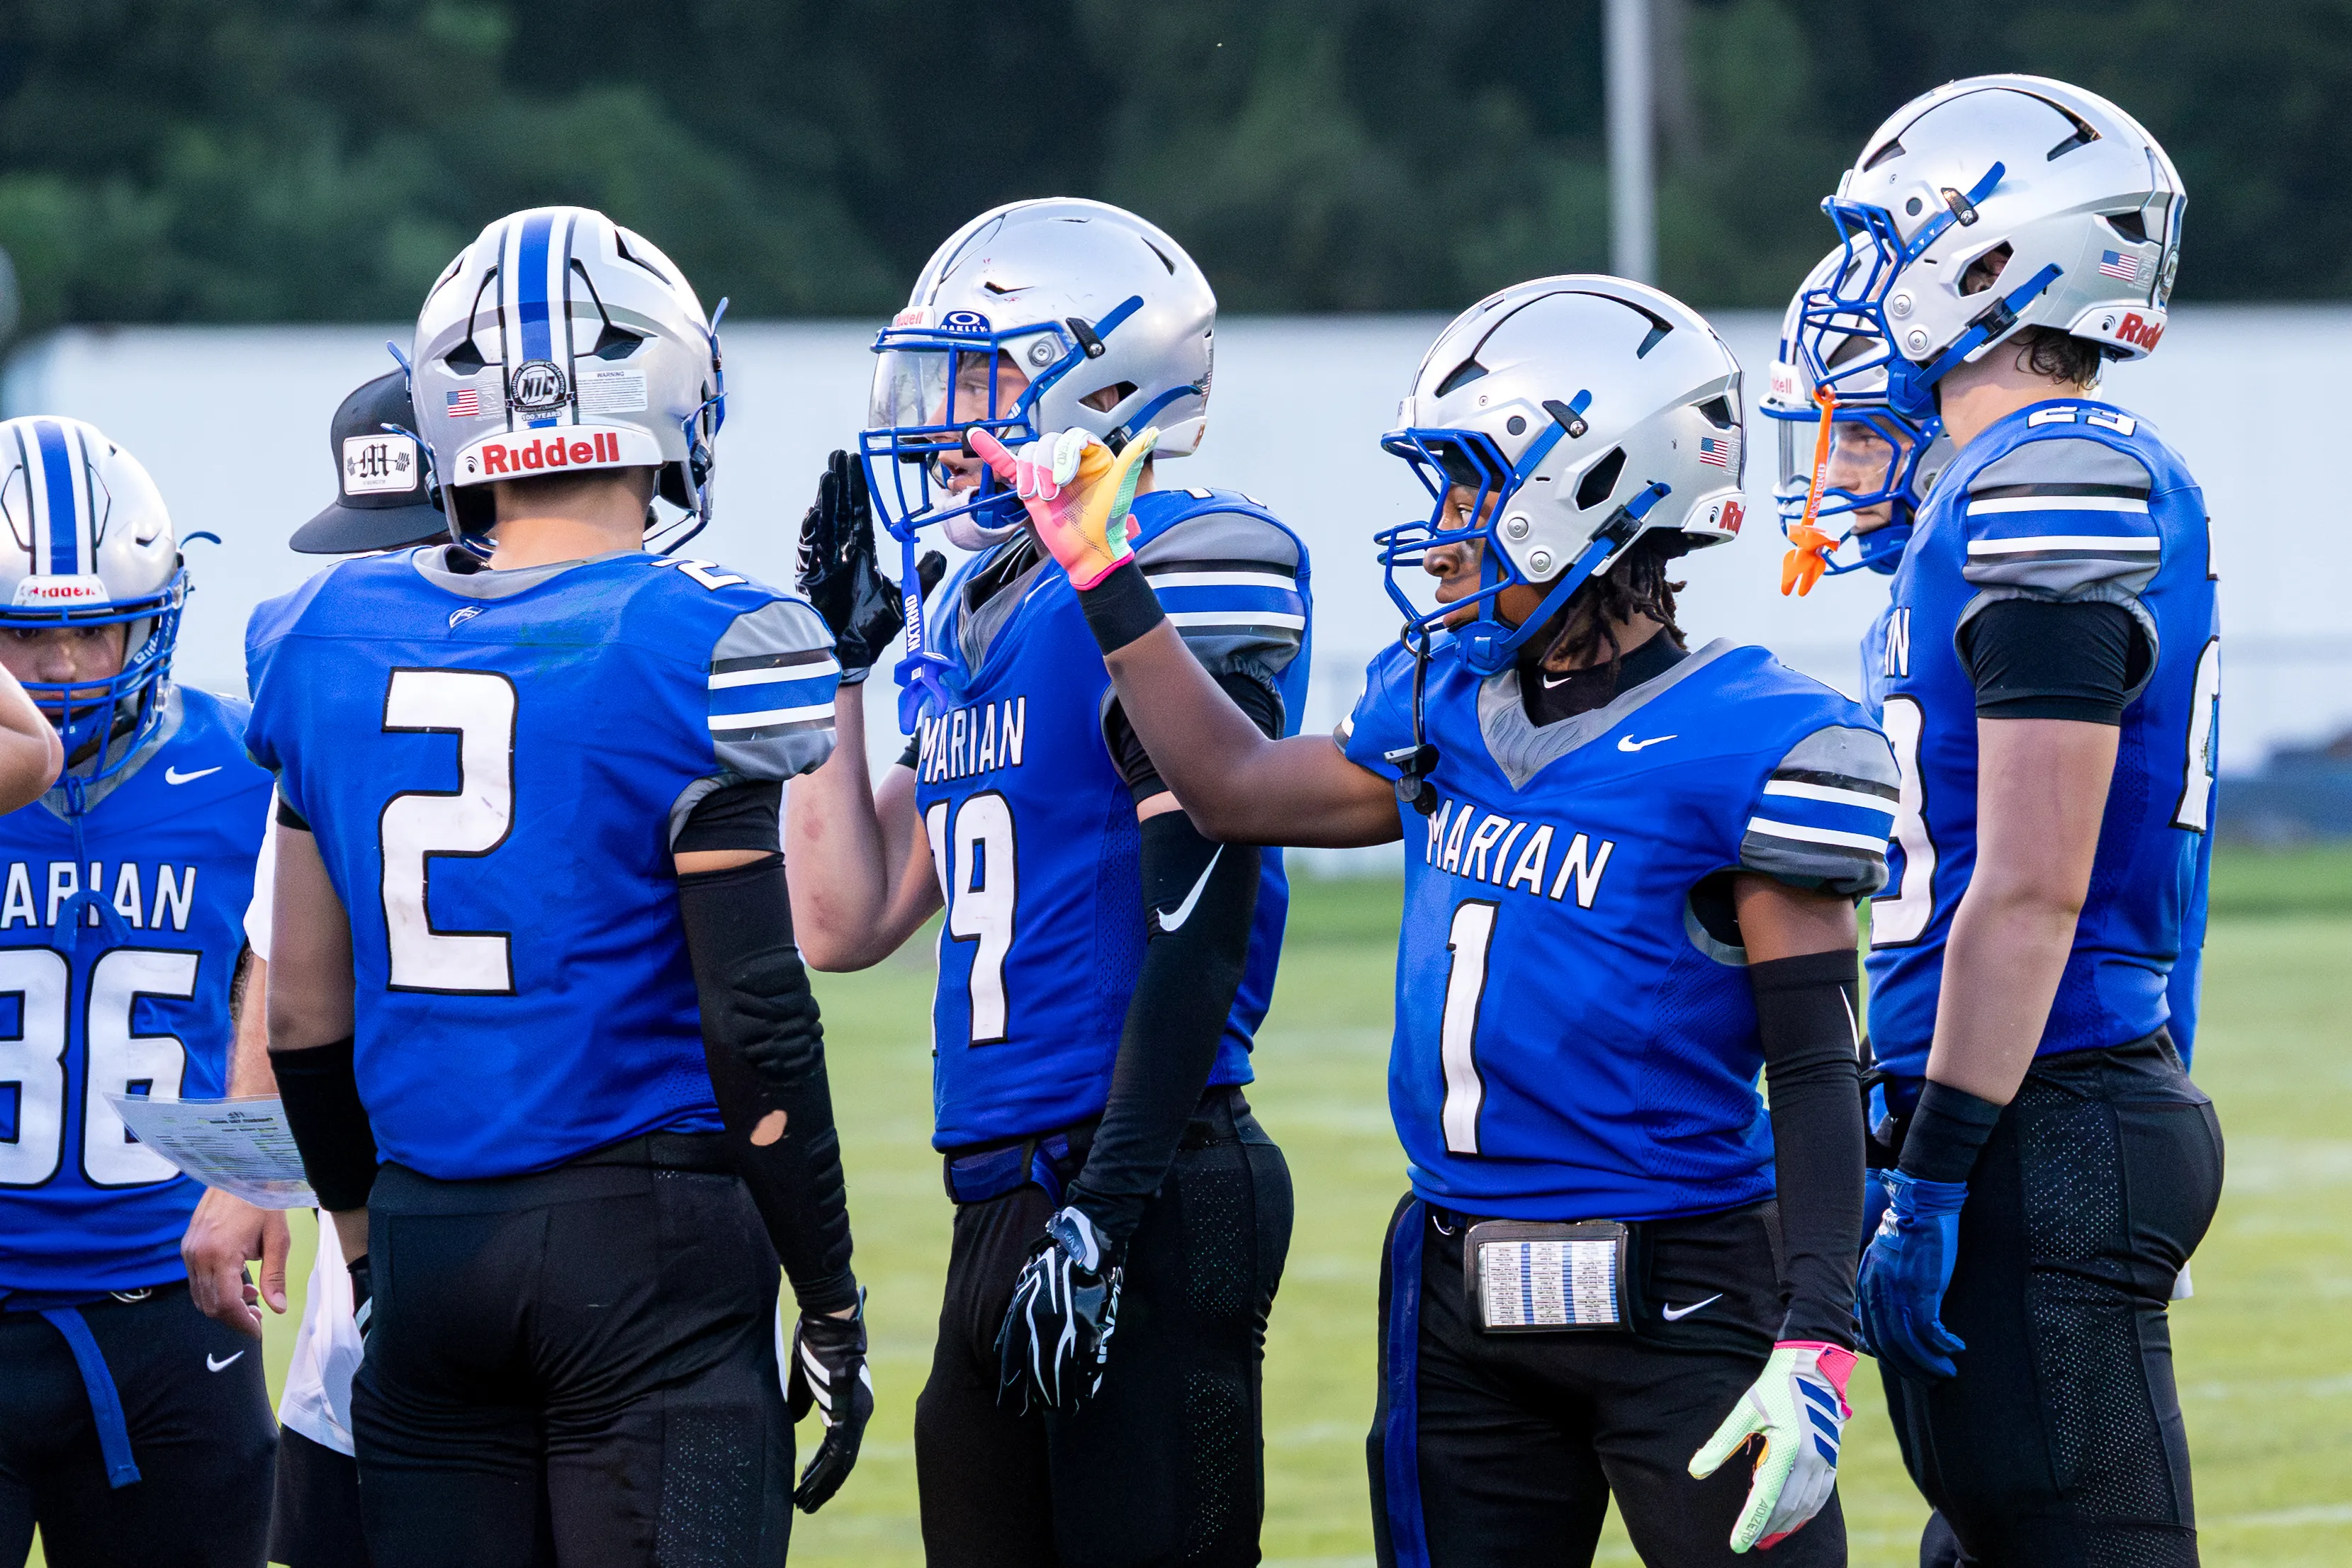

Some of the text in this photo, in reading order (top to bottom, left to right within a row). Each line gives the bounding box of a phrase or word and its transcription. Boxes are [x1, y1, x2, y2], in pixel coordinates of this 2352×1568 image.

[482, 432, 620, 475] Riddell
[522, 410, 562, 422] 100 YEARS
[648, 558, 750, 592] 2
[904, 594, 921, 653] NXTRND
[915, 695, 1025, 785] MARIAN
[378, 667, 519, 996] 2
[1426, 799, 1617, 910] MARIAN
[0, 860, 197, 932] ARIAN
[925, 789, 1019, 1056] 19
[0, 944, 203, 1190] 86
[1440, 897, 1502, 1158] 1
[1740, 1497, 1768, 1544] ADIZERO
